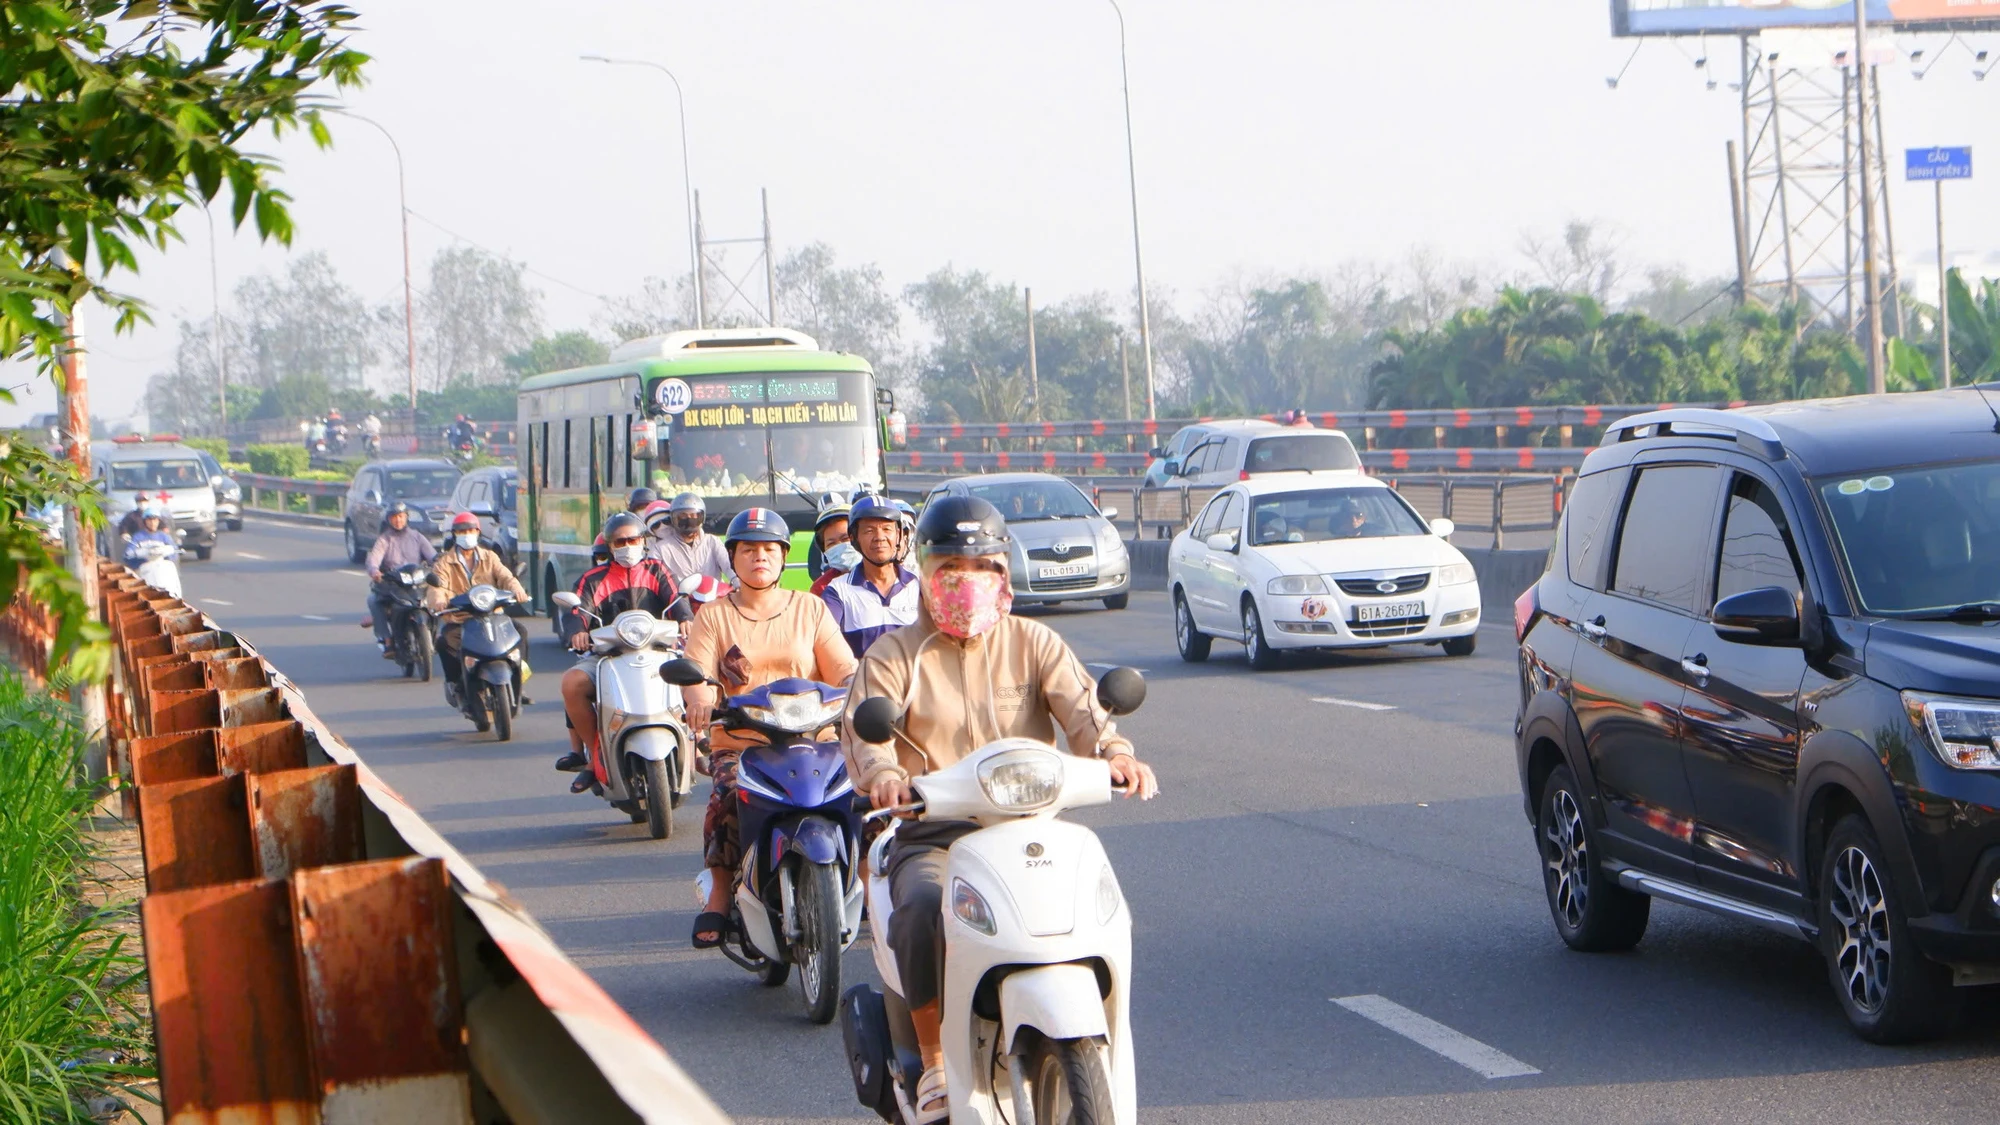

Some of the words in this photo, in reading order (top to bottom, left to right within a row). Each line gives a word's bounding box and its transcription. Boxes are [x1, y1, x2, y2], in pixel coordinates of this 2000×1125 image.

[662, 385, 684, 407] 622
[684, 409, 700, 427] BX
[701, 405, 723, 429] CHỢ
[724, 404, 745, 425] LỚN
[752, 406, 783, 427] RẠCH
[784, 401, 810, 423] KIẾN
[816, 401, 838, 423] TÂN
[838, 401, 858, 422] LÂN
[1025, 859, 1053, 869] SYM
